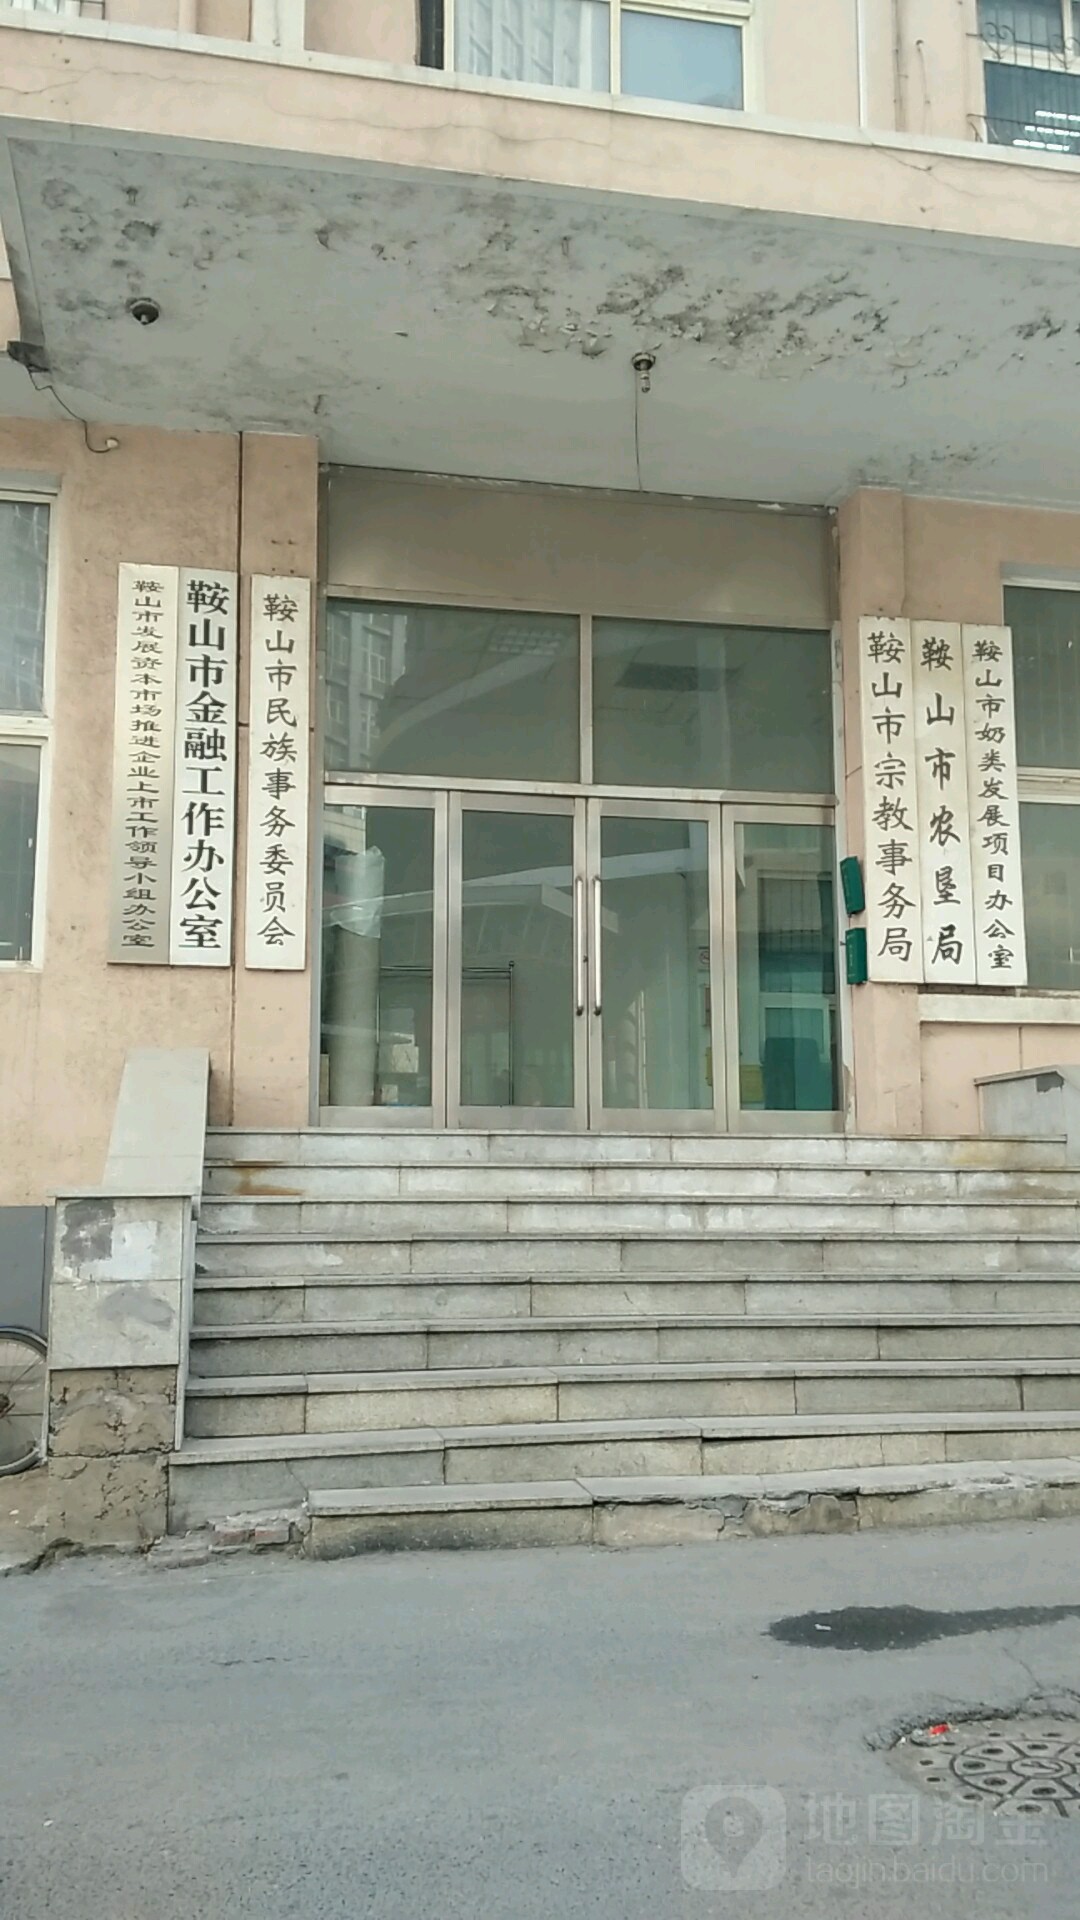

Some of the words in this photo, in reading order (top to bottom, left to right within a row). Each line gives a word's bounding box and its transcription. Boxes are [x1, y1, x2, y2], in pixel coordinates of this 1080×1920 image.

[121, 579, 164, 948] 鞍山市发展资本市场推进企业上市工作领导小组办公室
[178, 579, 230, 949] 鞍山市金融工作办公室
[257, 593, 299, 946] 鞍山市民族事务委员会
[867, 631, 916, 962] 鞍山市宗教事务局
[920, 636, 963, 965] 鞍山市农垦局
[972, 639, 1015, 969] 鞍山市奶类发展项目办公室
